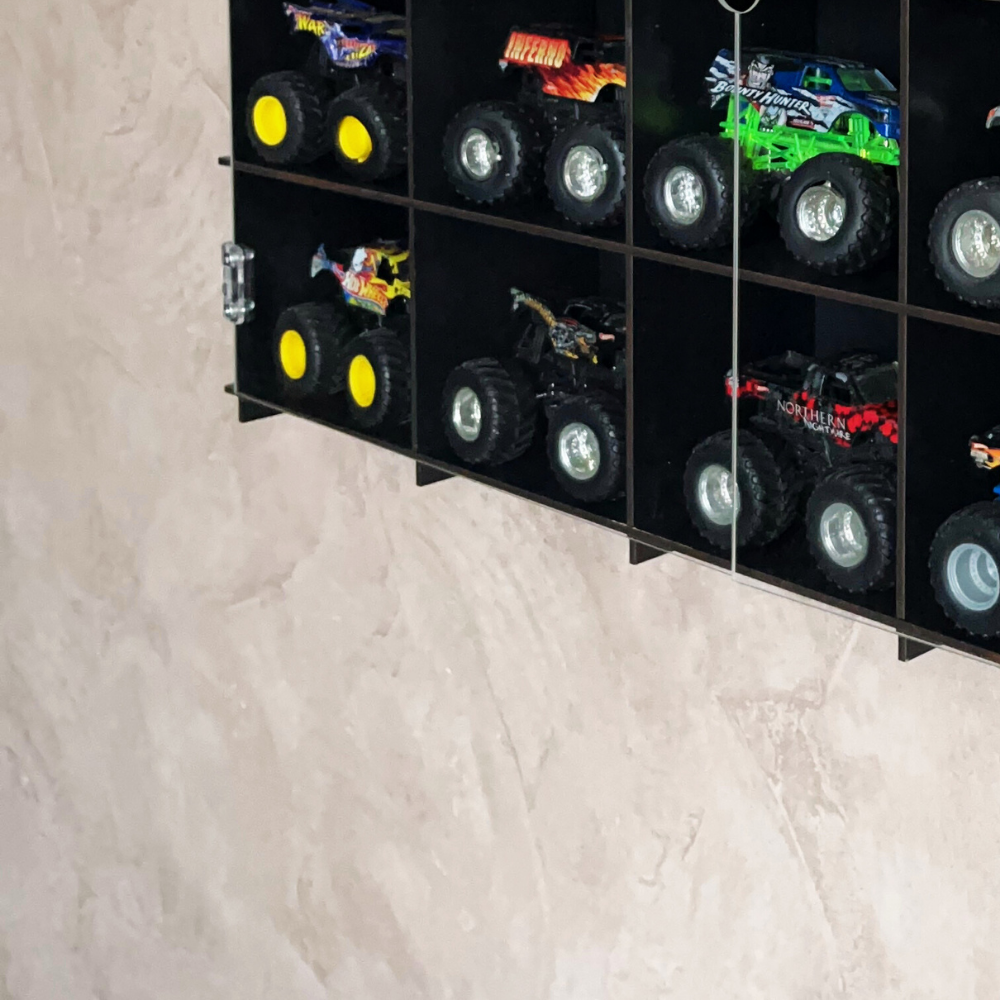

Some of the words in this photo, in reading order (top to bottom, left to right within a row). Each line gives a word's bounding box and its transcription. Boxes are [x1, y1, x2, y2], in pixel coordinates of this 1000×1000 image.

[298, 16, 326, 37] WAR
[504, 32, 567, 69] INFERNO
[758, 91, 812, 117] HUNTER
[776, 399, 846, 430] NORTHERN
